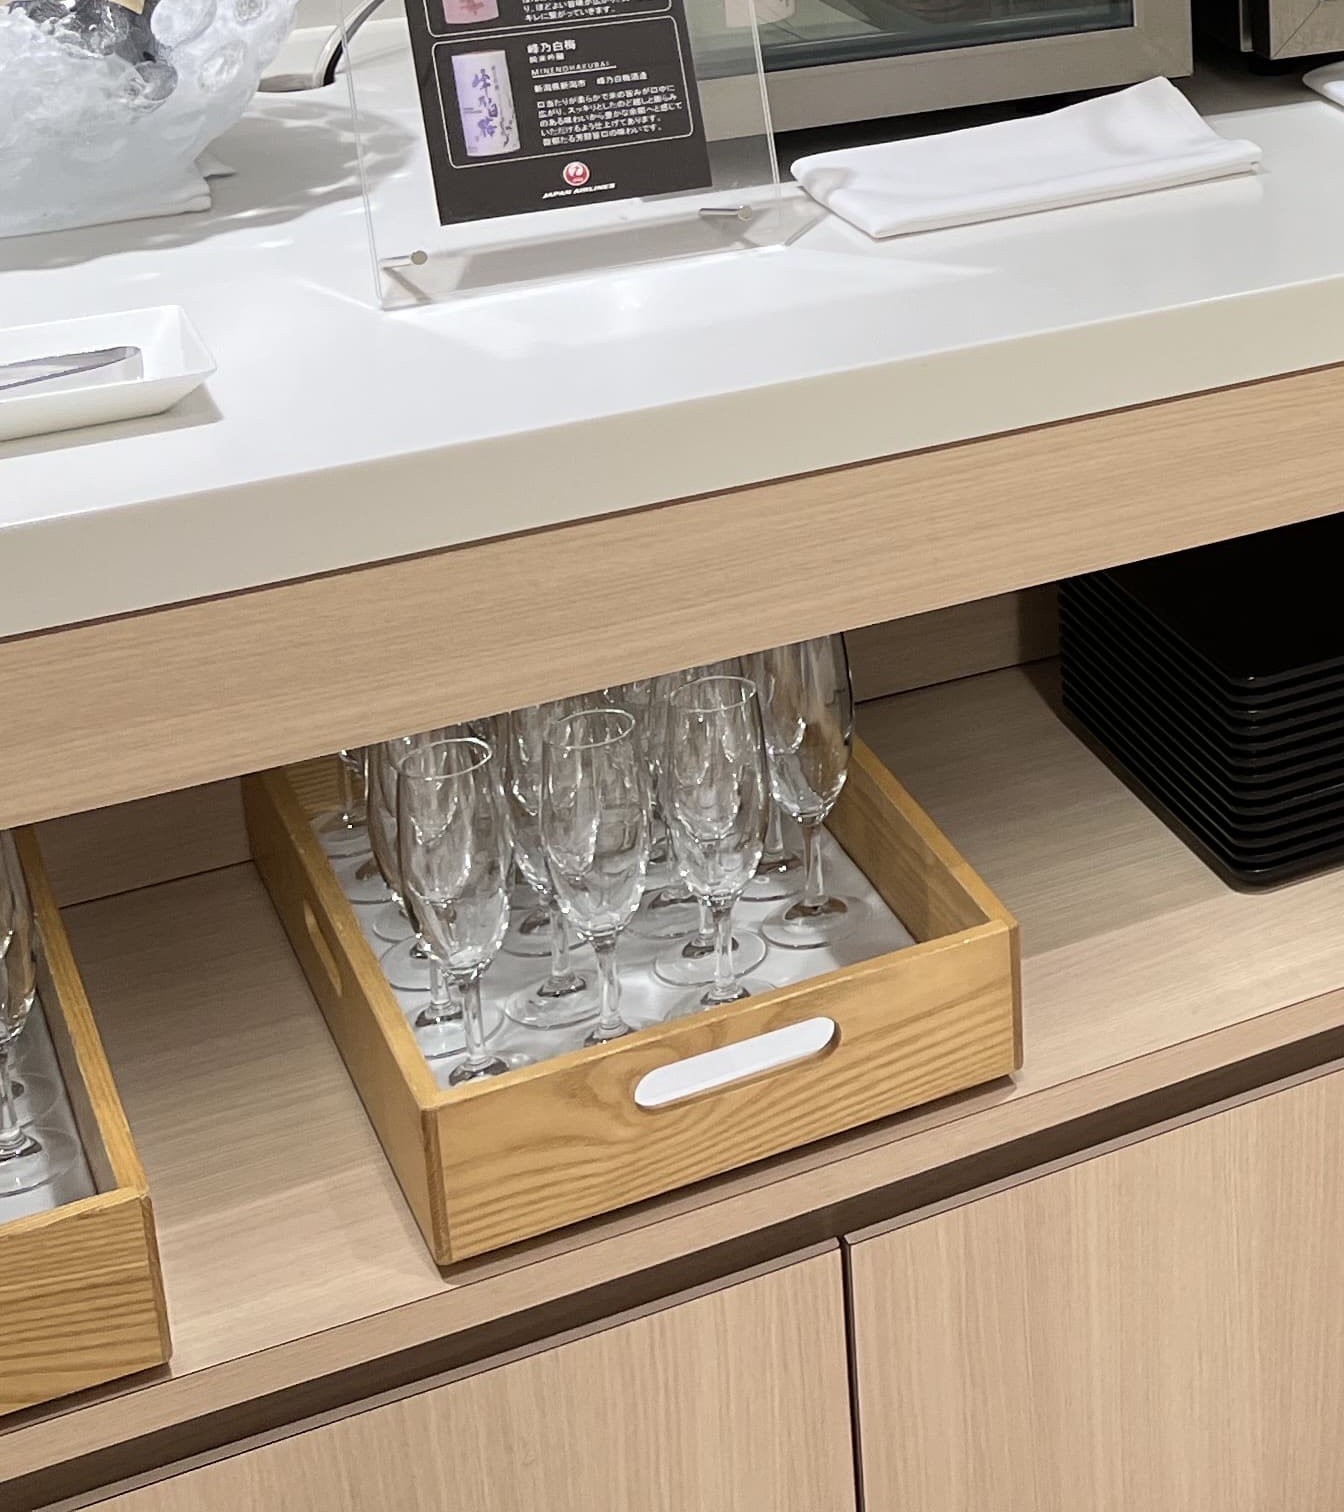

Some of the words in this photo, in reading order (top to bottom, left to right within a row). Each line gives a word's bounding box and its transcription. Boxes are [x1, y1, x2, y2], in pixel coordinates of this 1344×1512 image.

[526, 39, 577, 54] 峰乃白梅
[542, 189, 573, 199] JAPAN
[573, 182, 616, 194] AIRLINES
